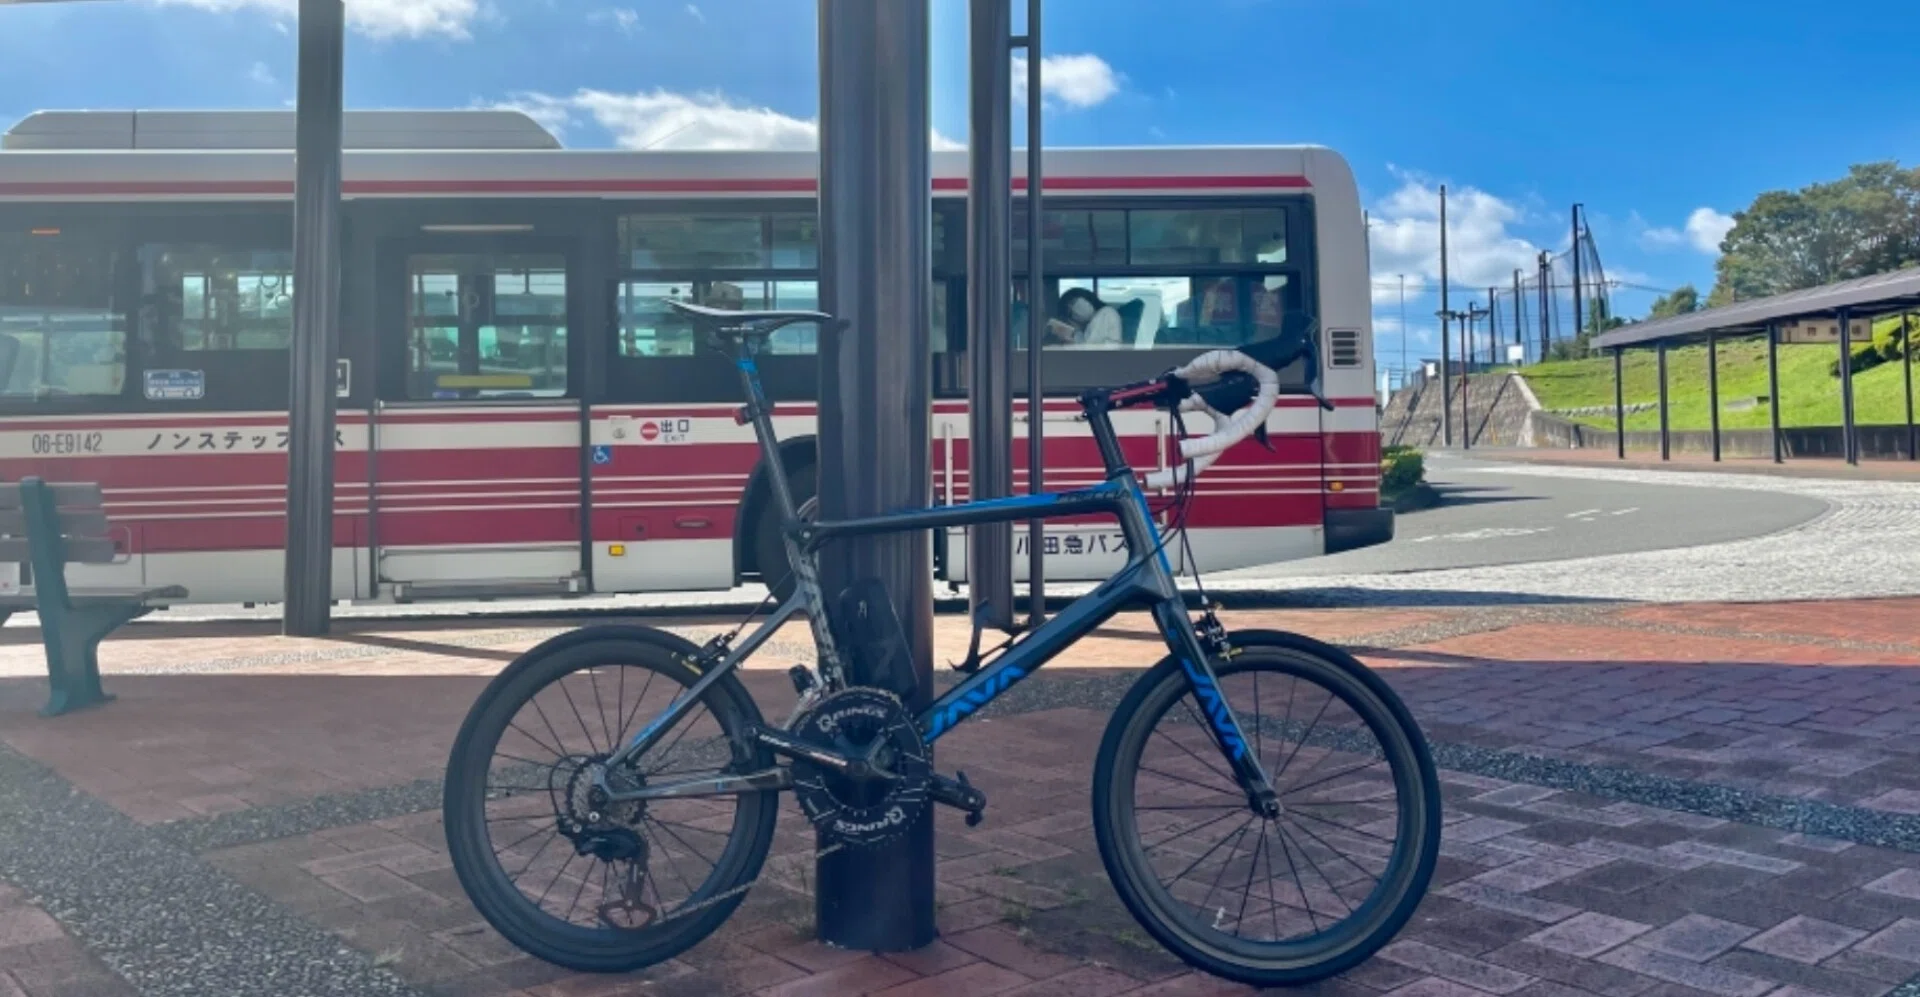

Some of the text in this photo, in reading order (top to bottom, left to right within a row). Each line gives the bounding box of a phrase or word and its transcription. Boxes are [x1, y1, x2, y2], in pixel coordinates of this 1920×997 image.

[32, 432, 103, 454] 06-E9142
[660, 418, 690, 433] 出口
[923, 663, 1026, 745] JAVA
[1181, 657, 1245, 762] JAVA
